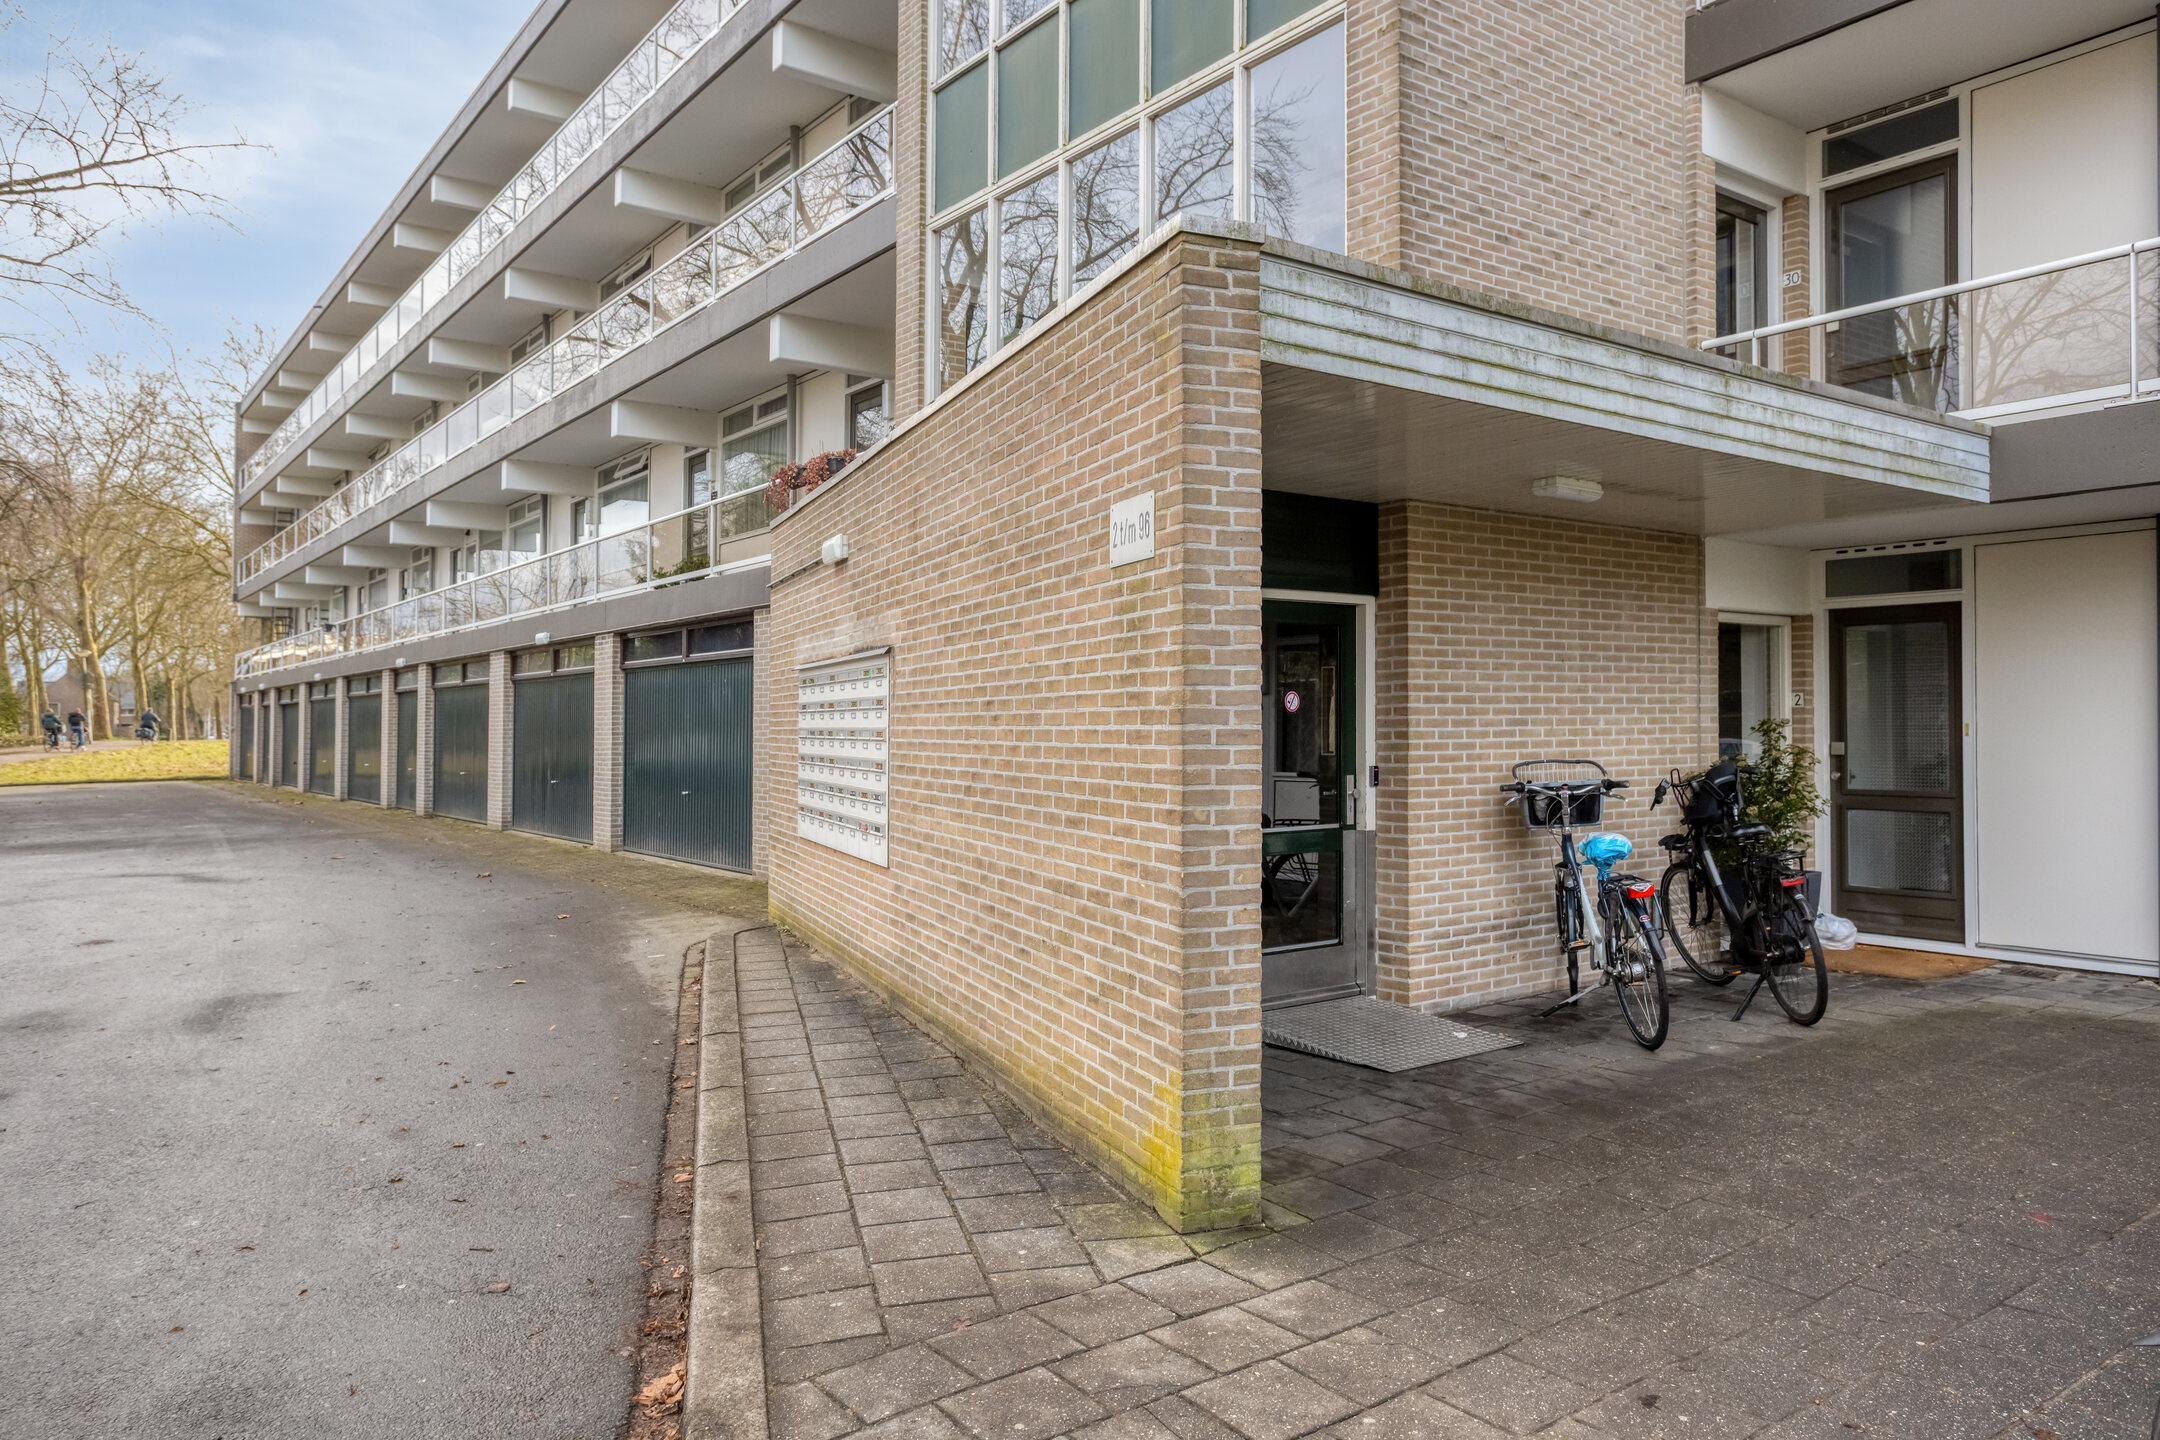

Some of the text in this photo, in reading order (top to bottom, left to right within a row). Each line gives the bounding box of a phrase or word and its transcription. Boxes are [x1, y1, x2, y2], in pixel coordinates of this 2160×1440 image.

[1785, 271, 1800, 286] 30
[1112, 511, 1150, 548] 2 t/m 96
[1794, 693, 1802, 706] 2
